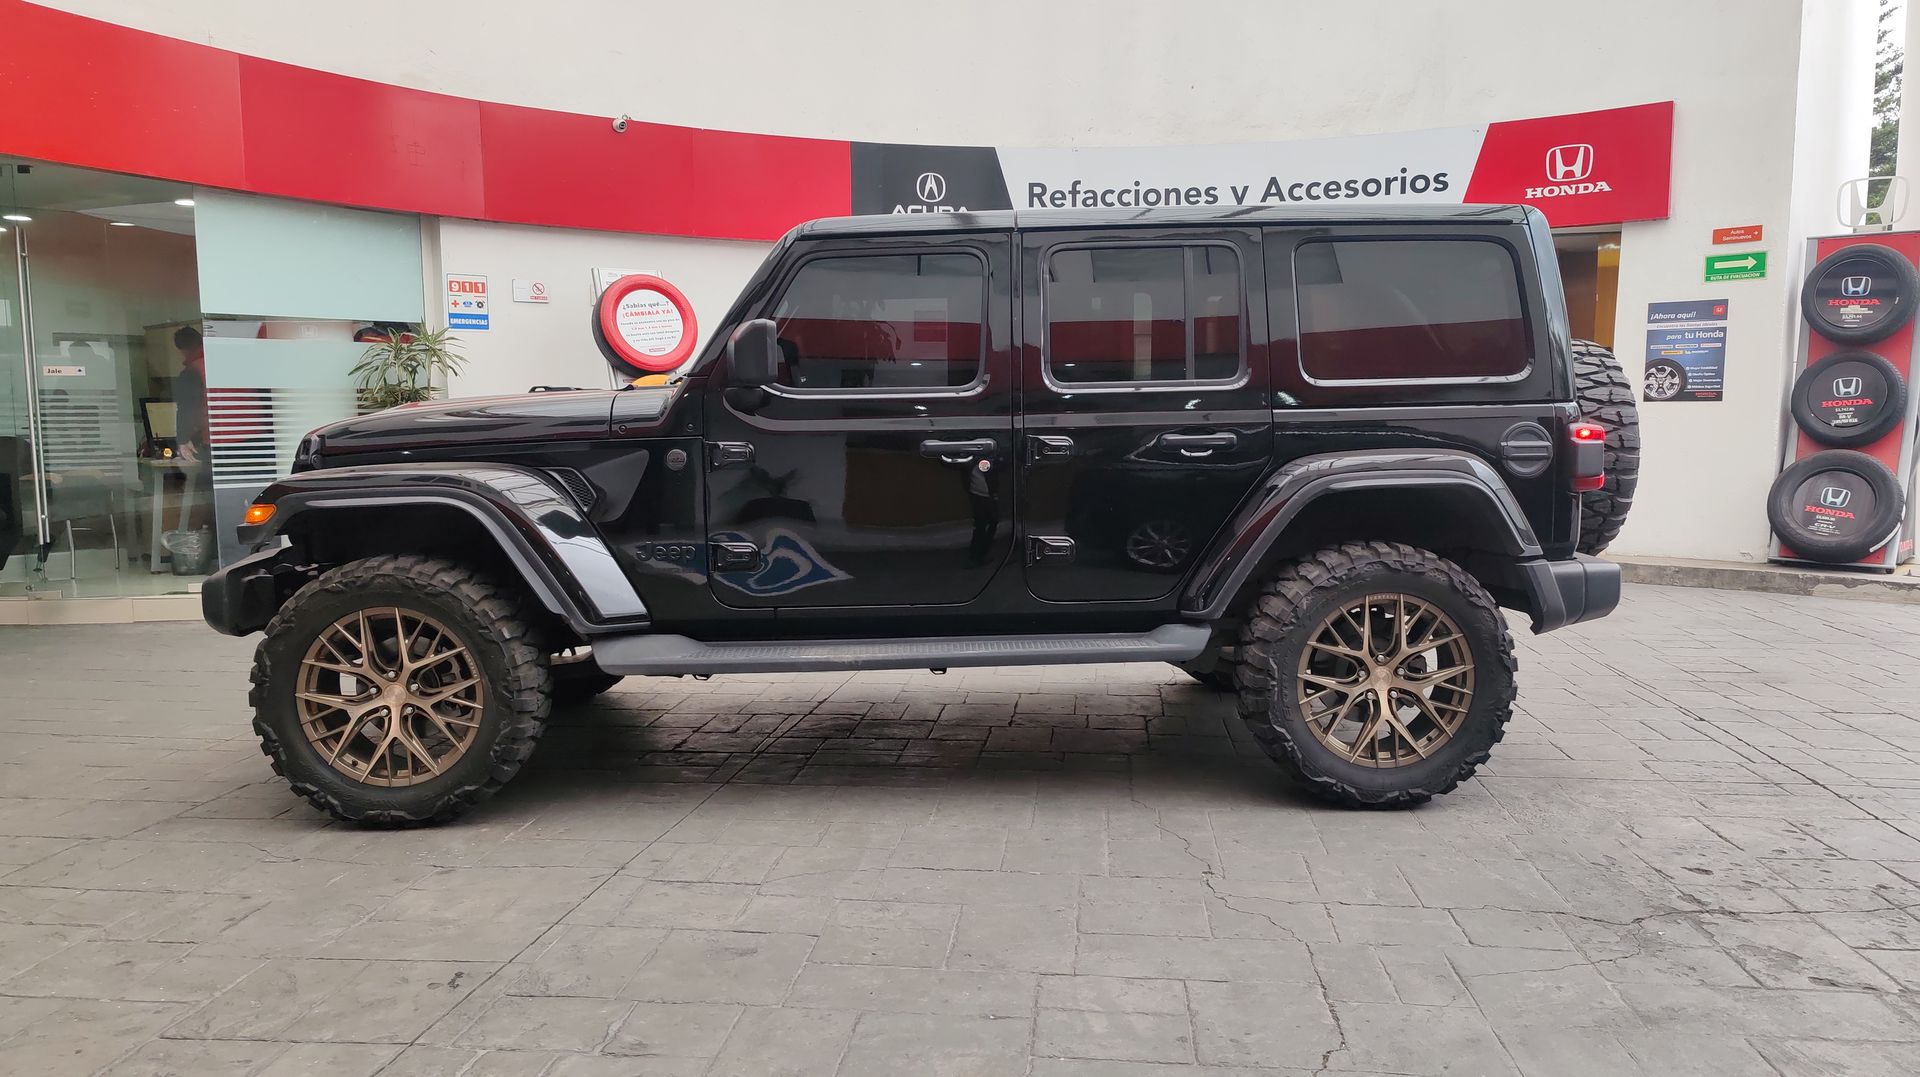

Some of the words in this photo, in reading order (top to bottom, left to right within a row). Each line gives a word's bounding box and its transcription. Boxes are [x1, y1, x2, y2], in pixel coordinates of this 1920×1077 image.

[1028, 180, 1219, 208] Refacciones
[1260, 167, 1449, 202] Accesorios
[1525, 181, 1612, 199] HONDA
[450, 282, 485, 293] 911
[1828, 298, 1881, 306] HONDA
[449, 318, 488, 326] EMERGENCIAS
[1684, 331, 1694, 339] tu
[1695, 330, 1724, 339] Honda
[1821, 398, 1873, 408] HONDA
[1804, 504, 1855, 519] HONDA
[635, 541, 696, 562] Jeep
